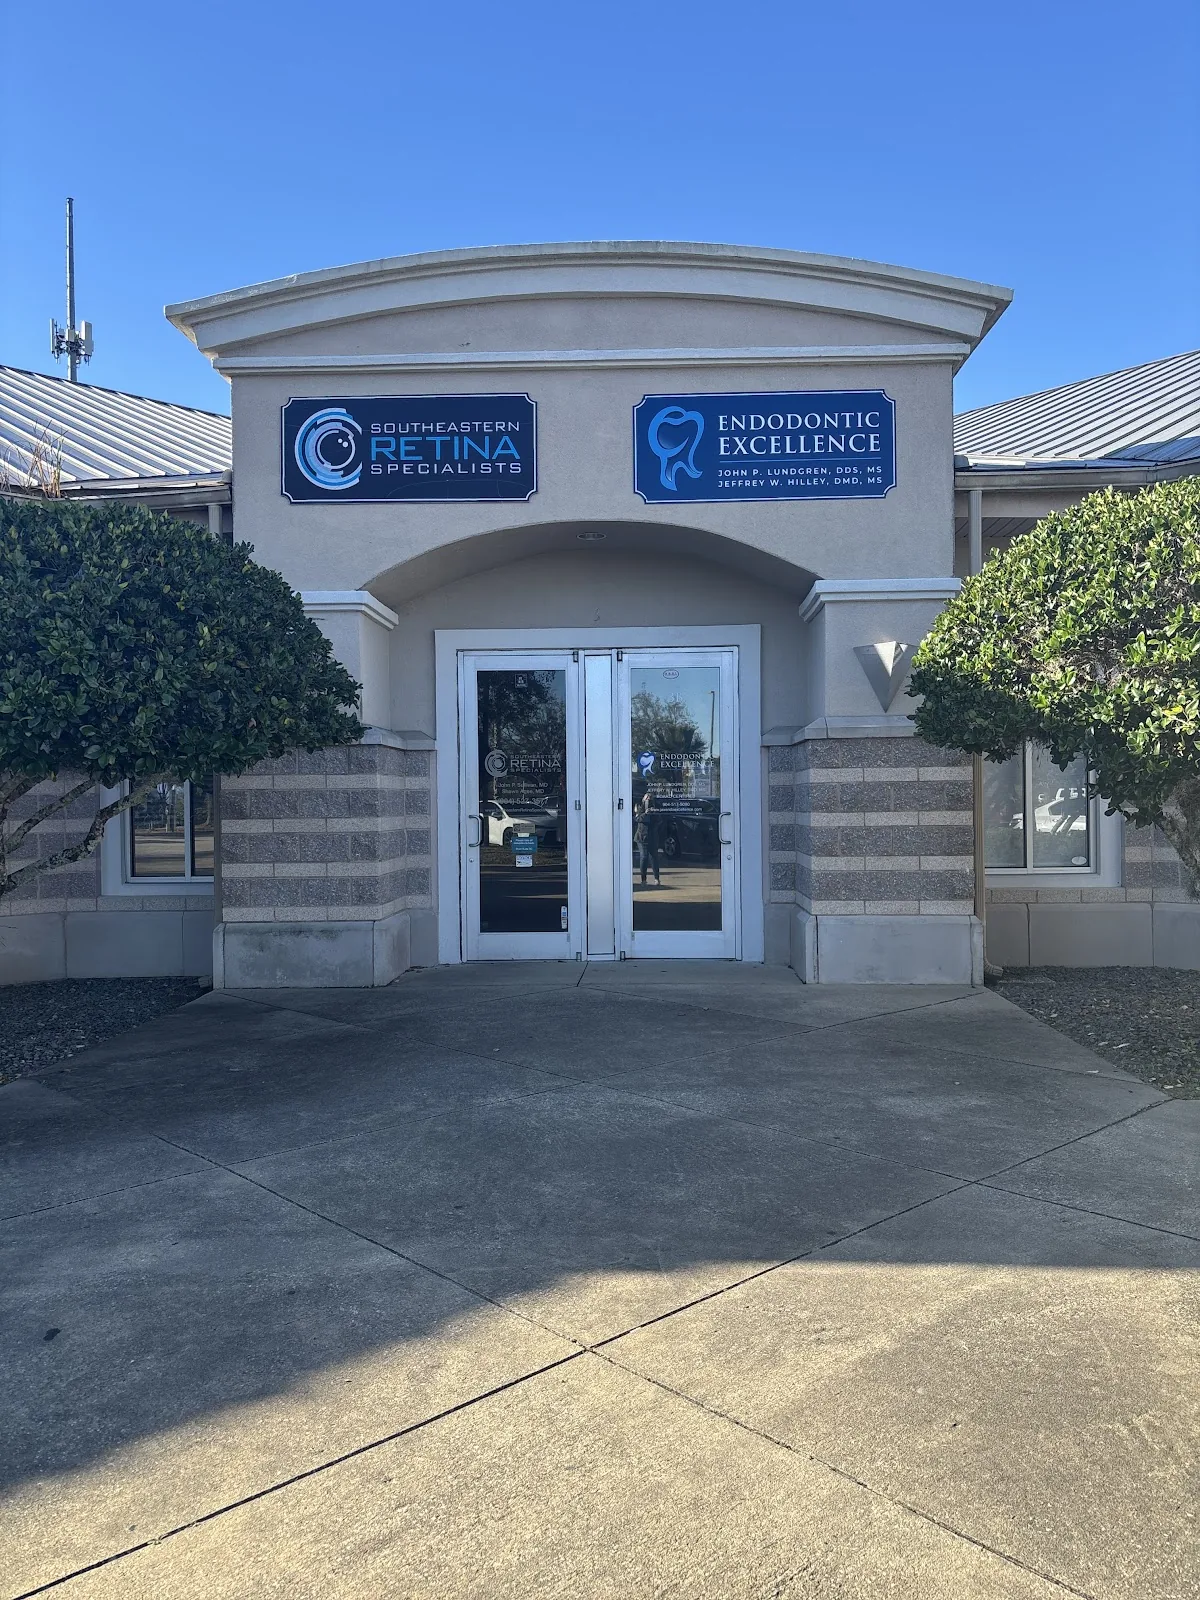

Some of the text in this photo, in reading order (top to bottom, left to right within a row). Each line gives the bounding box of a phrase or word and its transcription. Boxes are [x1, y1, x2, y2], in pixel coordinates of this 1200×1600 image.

[370, 421, 520, 434] SOUTHEASTERN
[718, 411, 880, 431] ENDODONTIC
[370, 435, 521, 461] RETINA
[718, 433, 881, 456] EXCELLENCE
[370, 462, 522, 475] SPECIALISTS
[718, 469, 748, 477] JOHN
[752, 468, 762, 476] P.
[767, 467, 831, 476] LUNDGREN,
[836, 466, 862, 475] DDS,
[718, 479, 765, 488] JEFFREY
[787, 477, 829, 487] HILLEY,
[834, 477, 862, 485] DMD,
[867, 476, 882, 484] MS
[510, 759, 561, 768] RETINA
